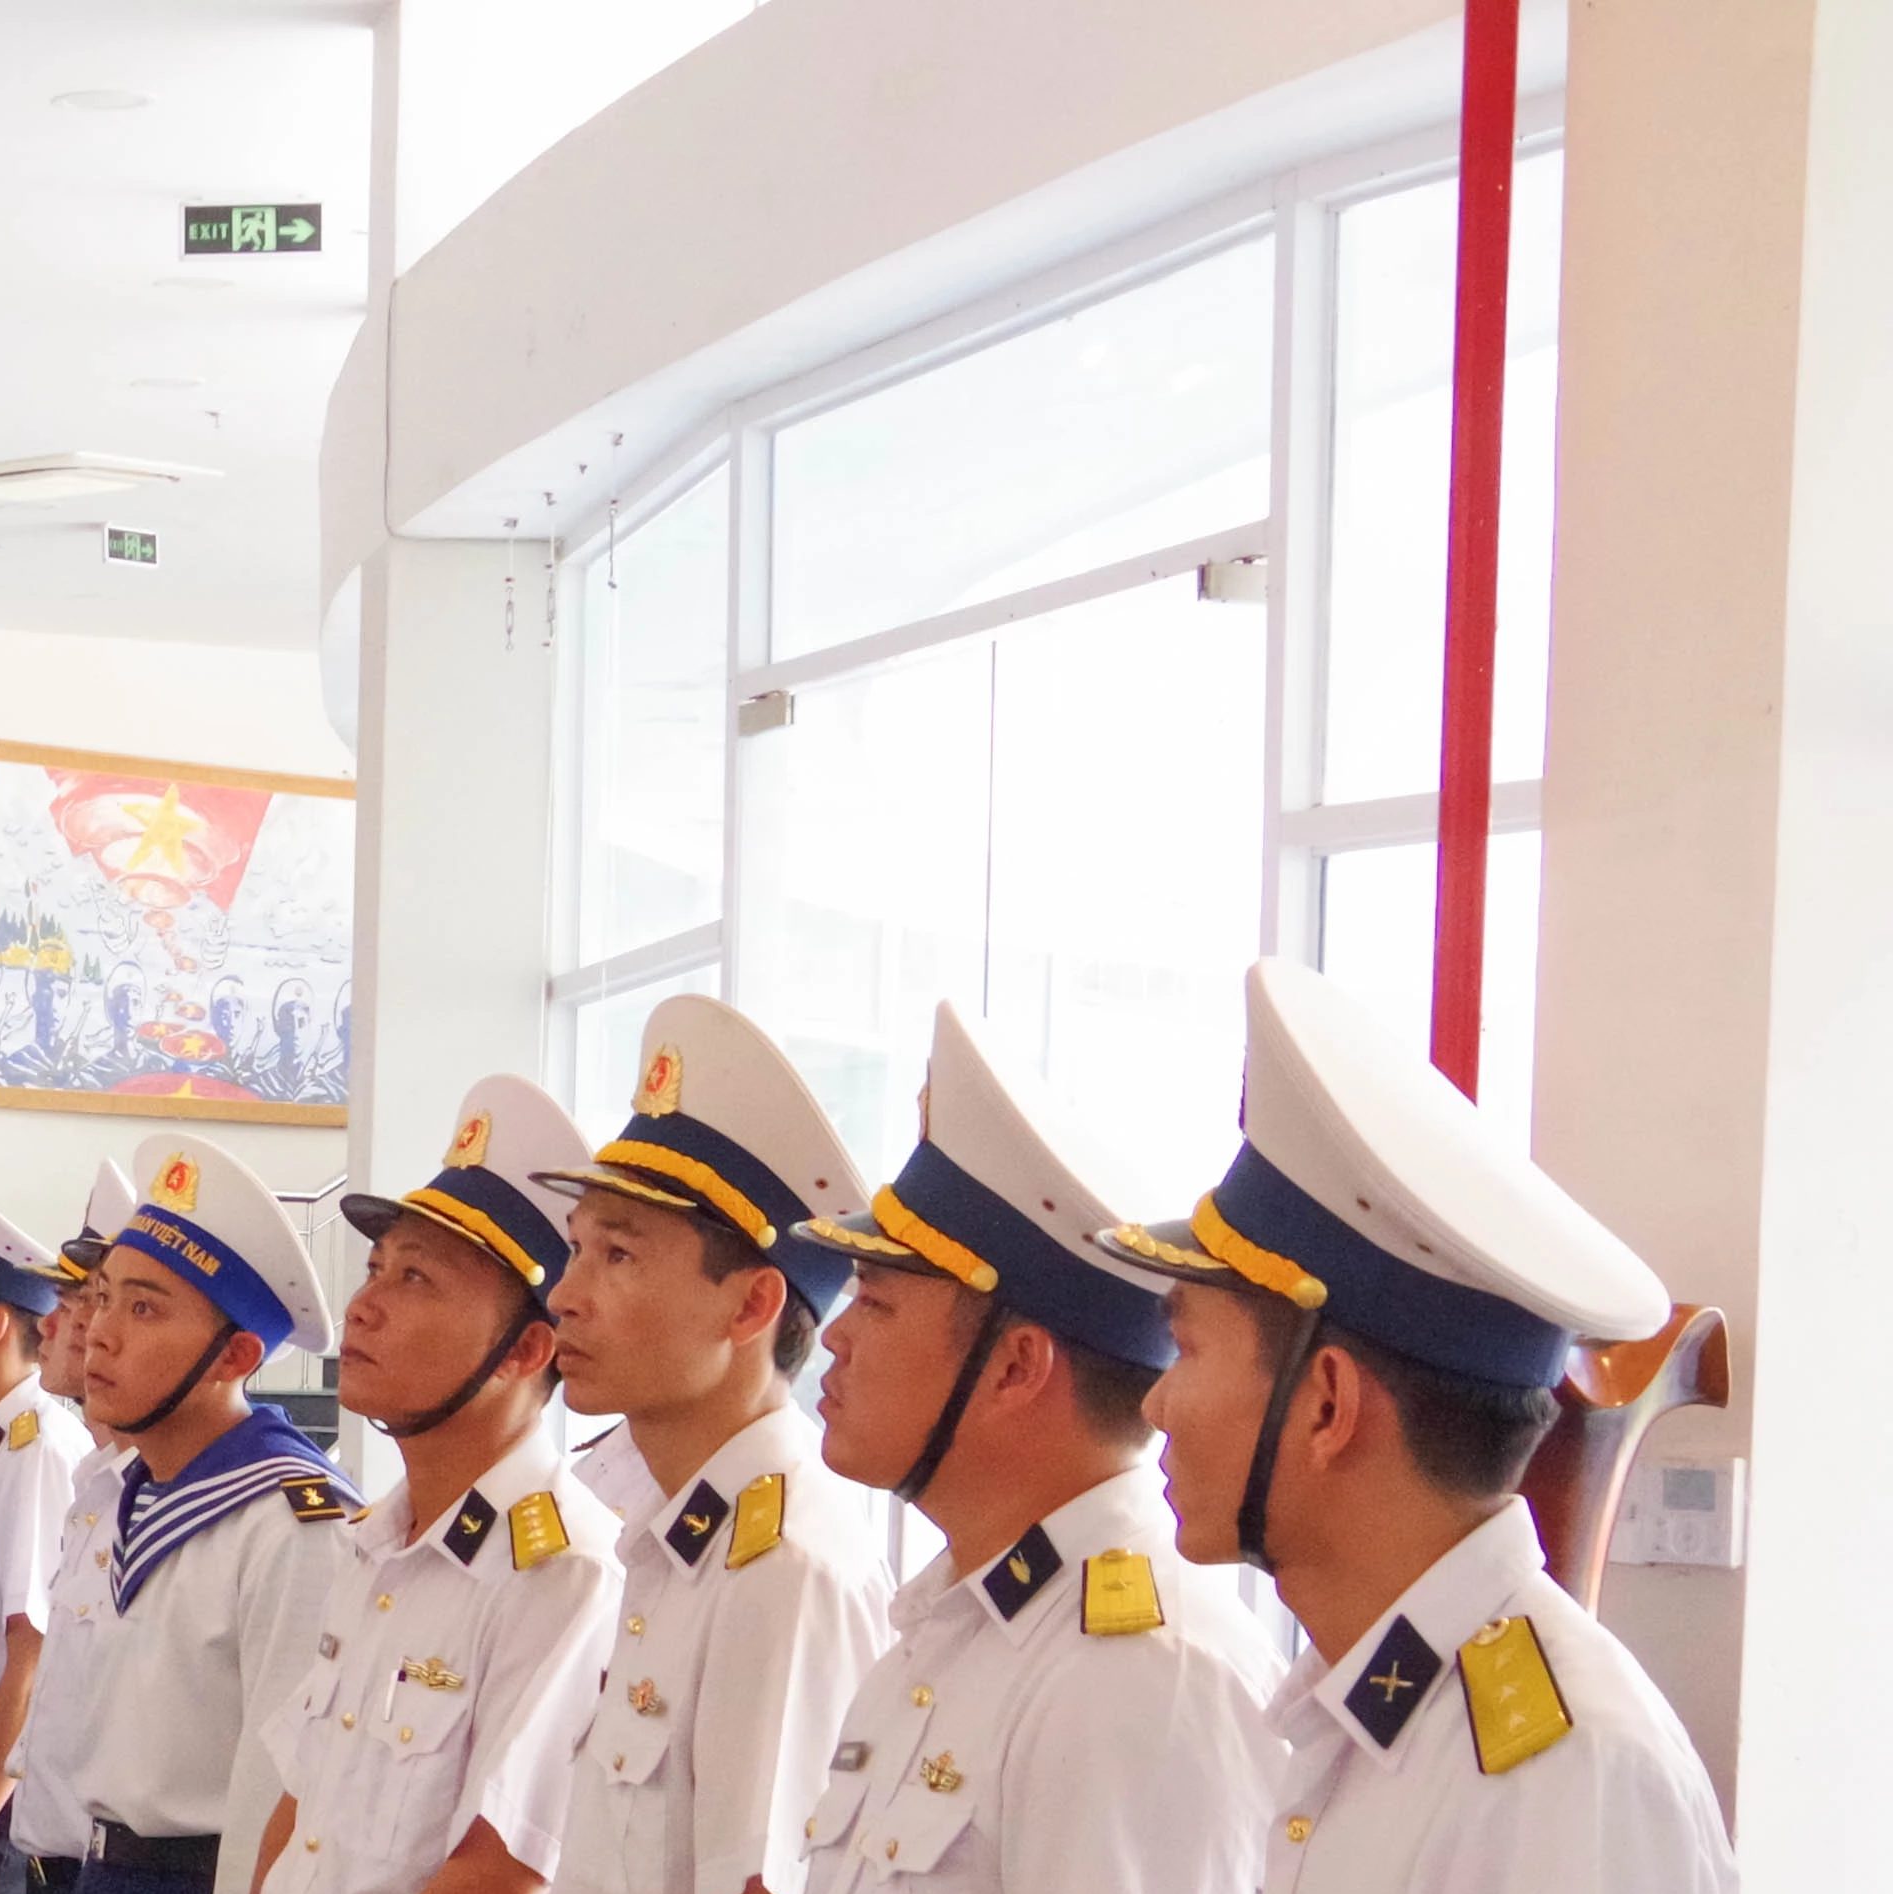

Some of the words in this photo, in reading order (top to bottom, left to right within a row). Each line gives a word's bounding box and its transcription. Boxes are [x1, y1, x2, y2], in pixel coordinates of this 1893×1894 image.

[188, 223, 229, 240] EXIT
[151, 1221, 188, 1250] VIỆT
[181, 1240, 222, 1277] NAM
